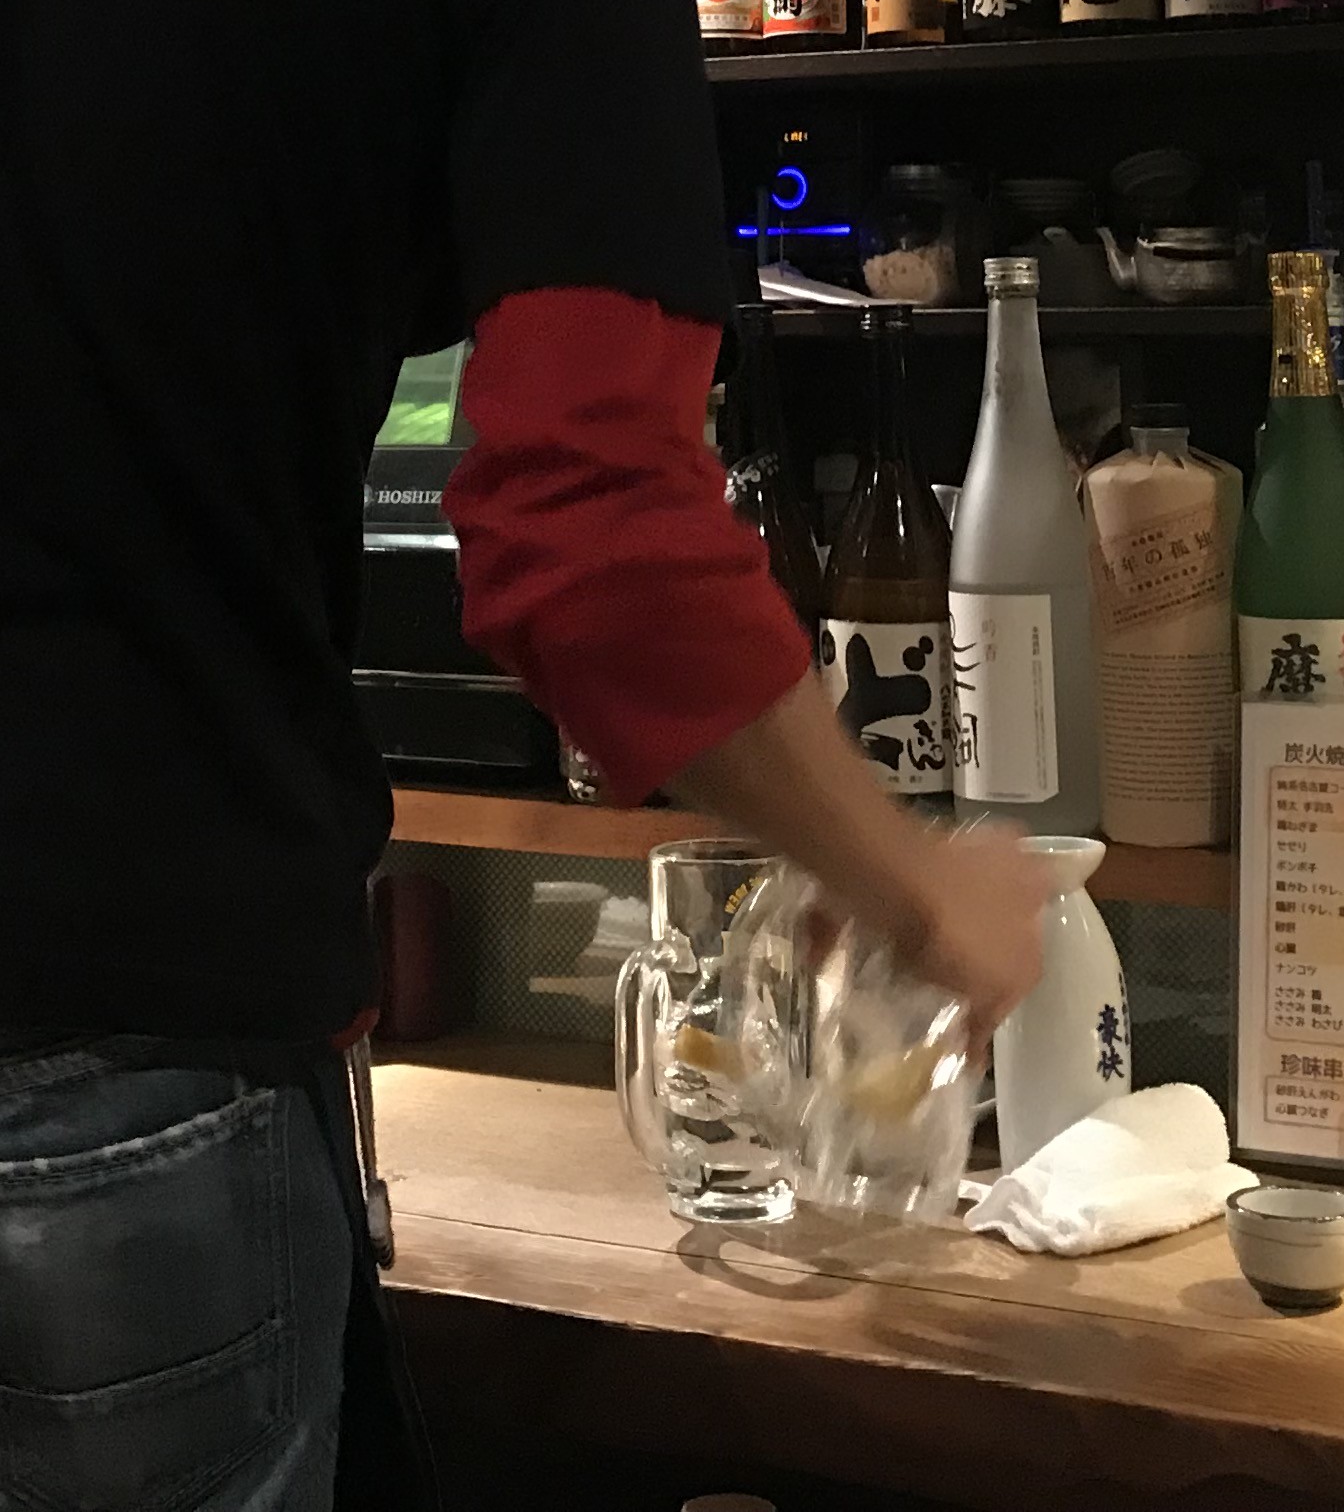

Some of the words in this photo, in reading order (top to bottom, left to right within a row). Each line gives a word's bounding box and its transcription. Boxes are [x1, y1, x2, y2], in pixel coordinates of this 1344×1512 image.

[377, 490, 443, 505] HOSHIZ
[1095, 1003, 1126, 1083] 豪快
[1280, 1053, 1344, 1080] 珍味串
